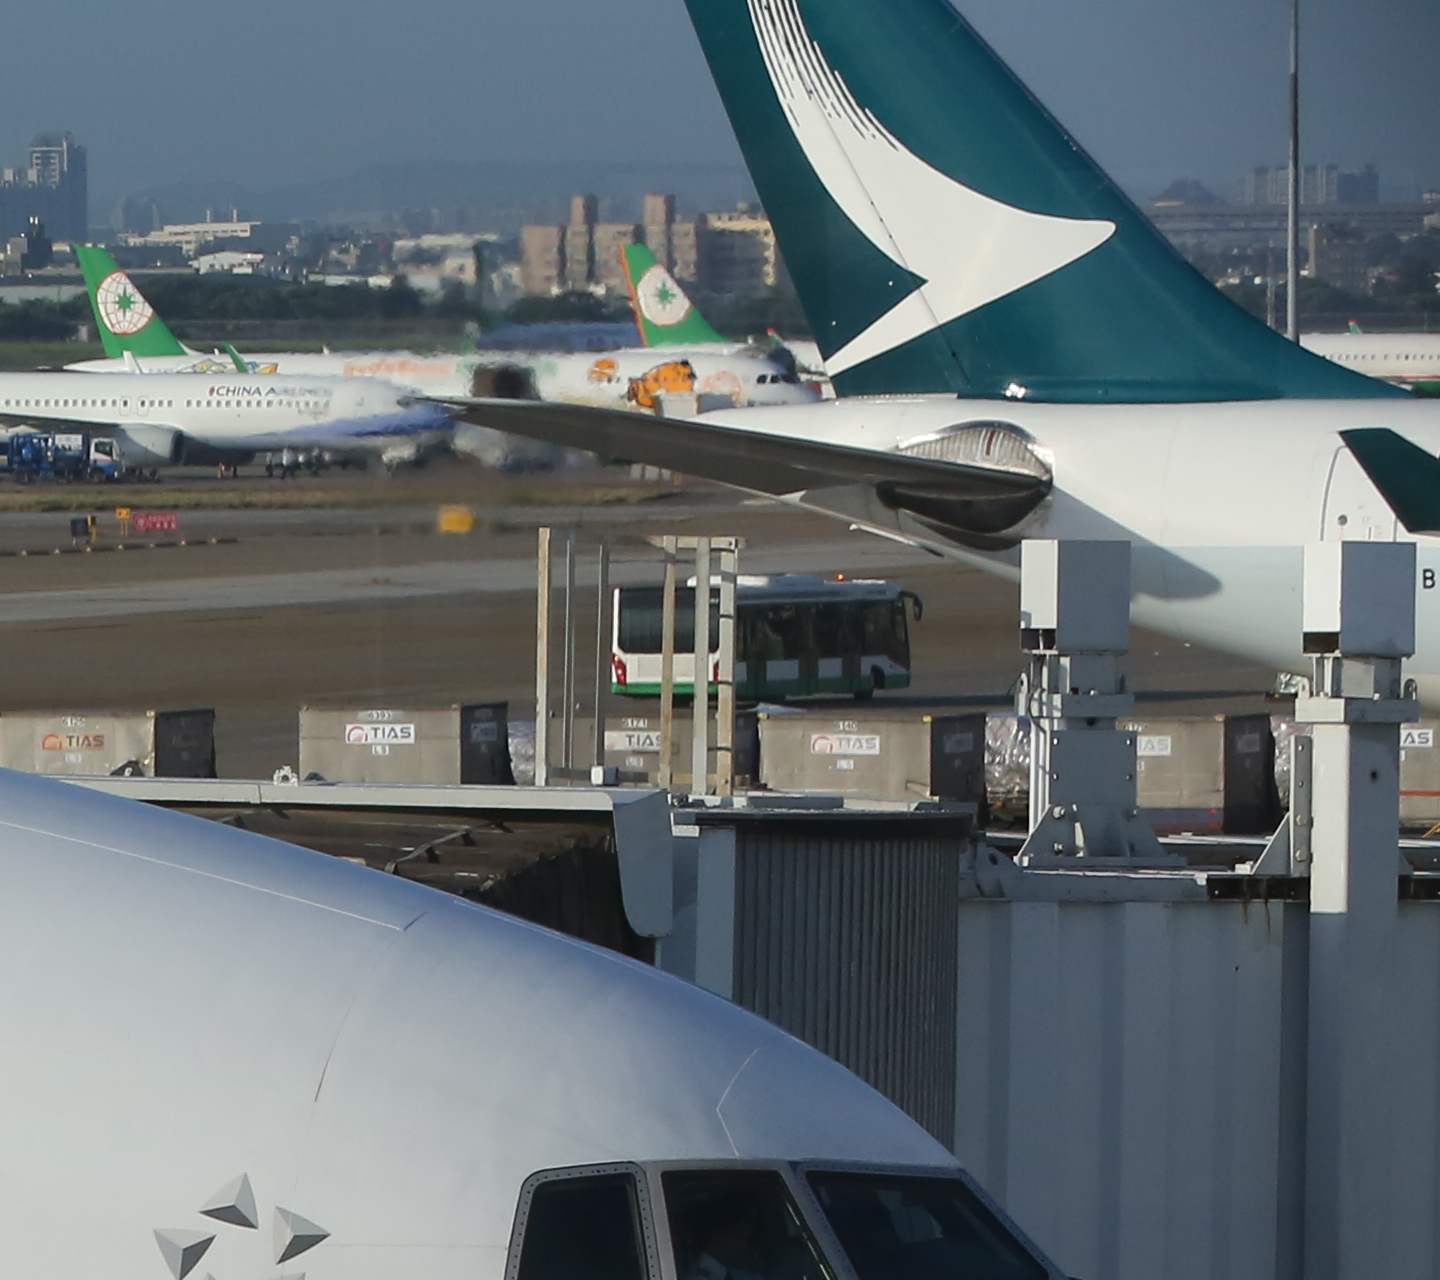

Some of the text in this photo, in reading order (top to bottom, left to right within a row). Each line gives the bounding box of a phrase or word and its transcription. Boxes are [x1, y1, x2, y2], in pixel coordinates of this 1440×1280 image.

[215, 386, 262, 397] CHINA
[370, 726, 412, 739] TIAS
[66, 734, 105, 748] TIAS
[836, 737, 877, 750] TIAS
